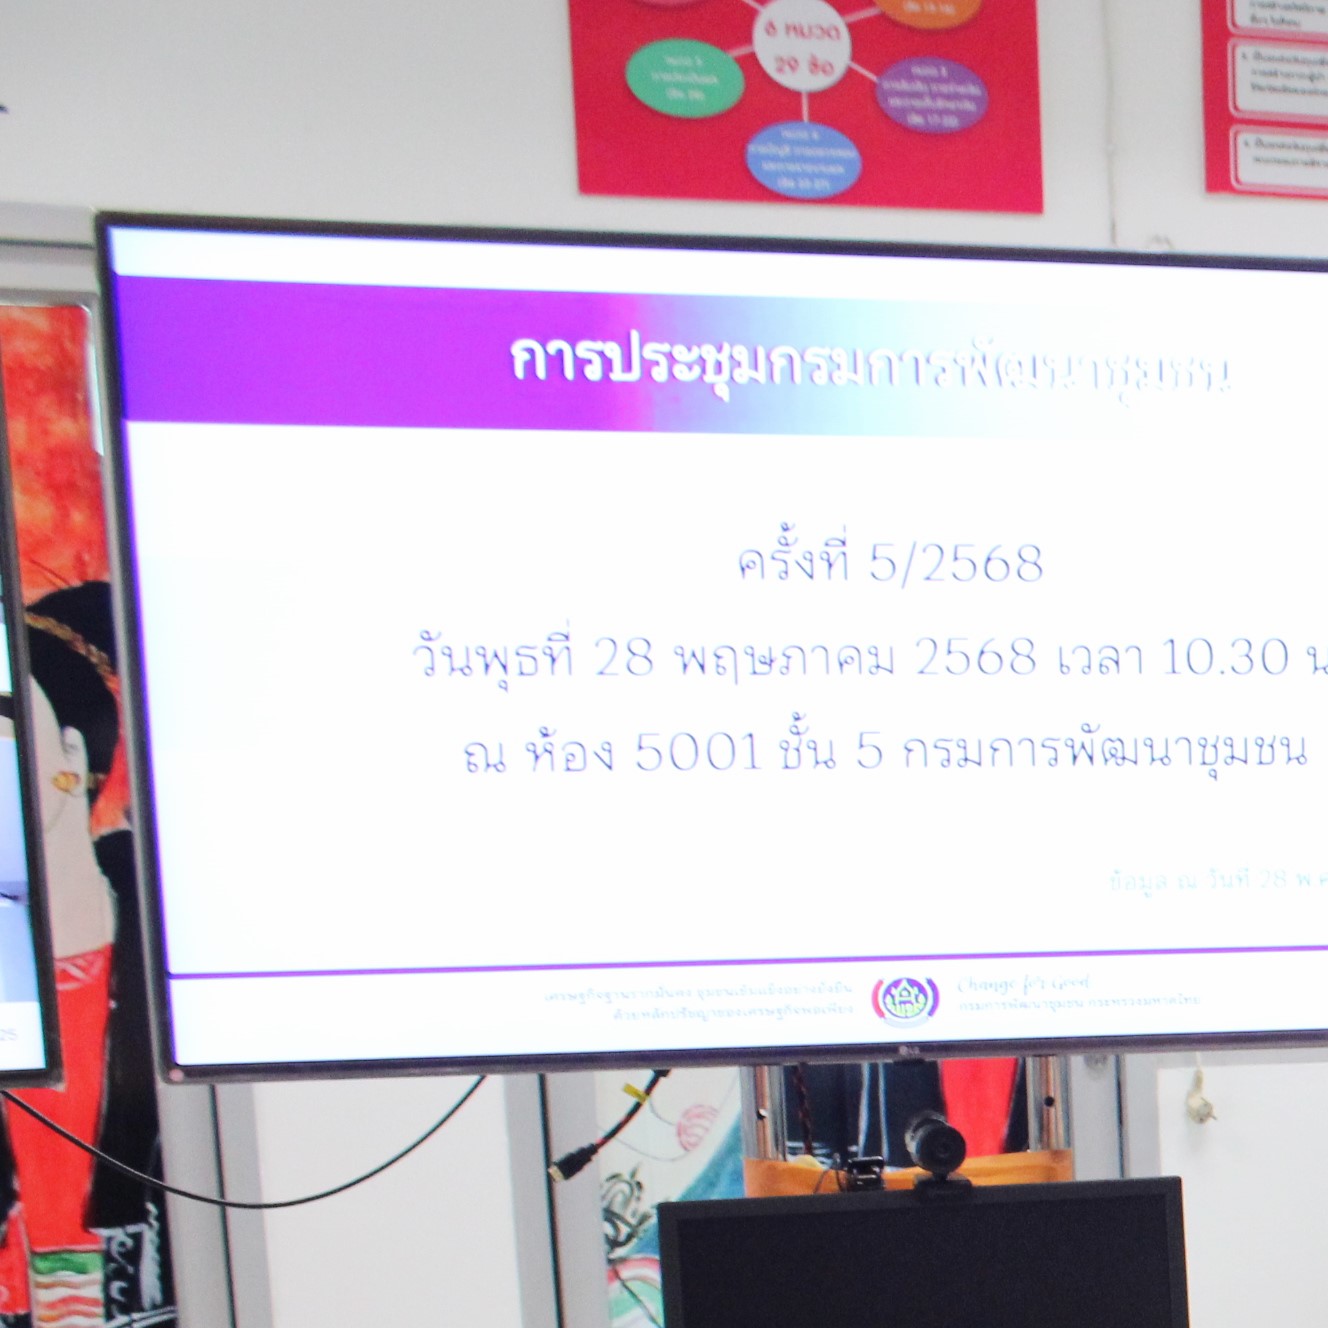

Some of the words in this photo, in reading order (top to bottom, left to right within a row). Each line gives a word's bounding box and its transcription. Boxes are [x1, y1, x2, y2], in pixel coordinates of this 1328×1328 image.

[510, 328, 1232, 409] การประชุมกรมการพัฒนาชุมชน
[737, 520, 849, 581] ครั้งที่
[869, 540, 1044, 590] 5/2568
[412, 619, 573, 694] วันพุธที่
[594, 636, 654, 677] 28
[673, 644, 895, 686] พฤษภาคม
[915, 636, 1037, 676] 2568
[1058, 644, 1143, 676] เวลา
[1162, 636, 1289, 676] 10.30
[463, 741, 507, 774] ณ
[524, 725, 614, 773] ห้อง
[635, 731, 762, 772] 5001
[778, 711, 837, 771] ชั้น
[856, 730, 884, 770] 5
[902, 722, 1308, 782] กรมการพัฒนาชุมชน
